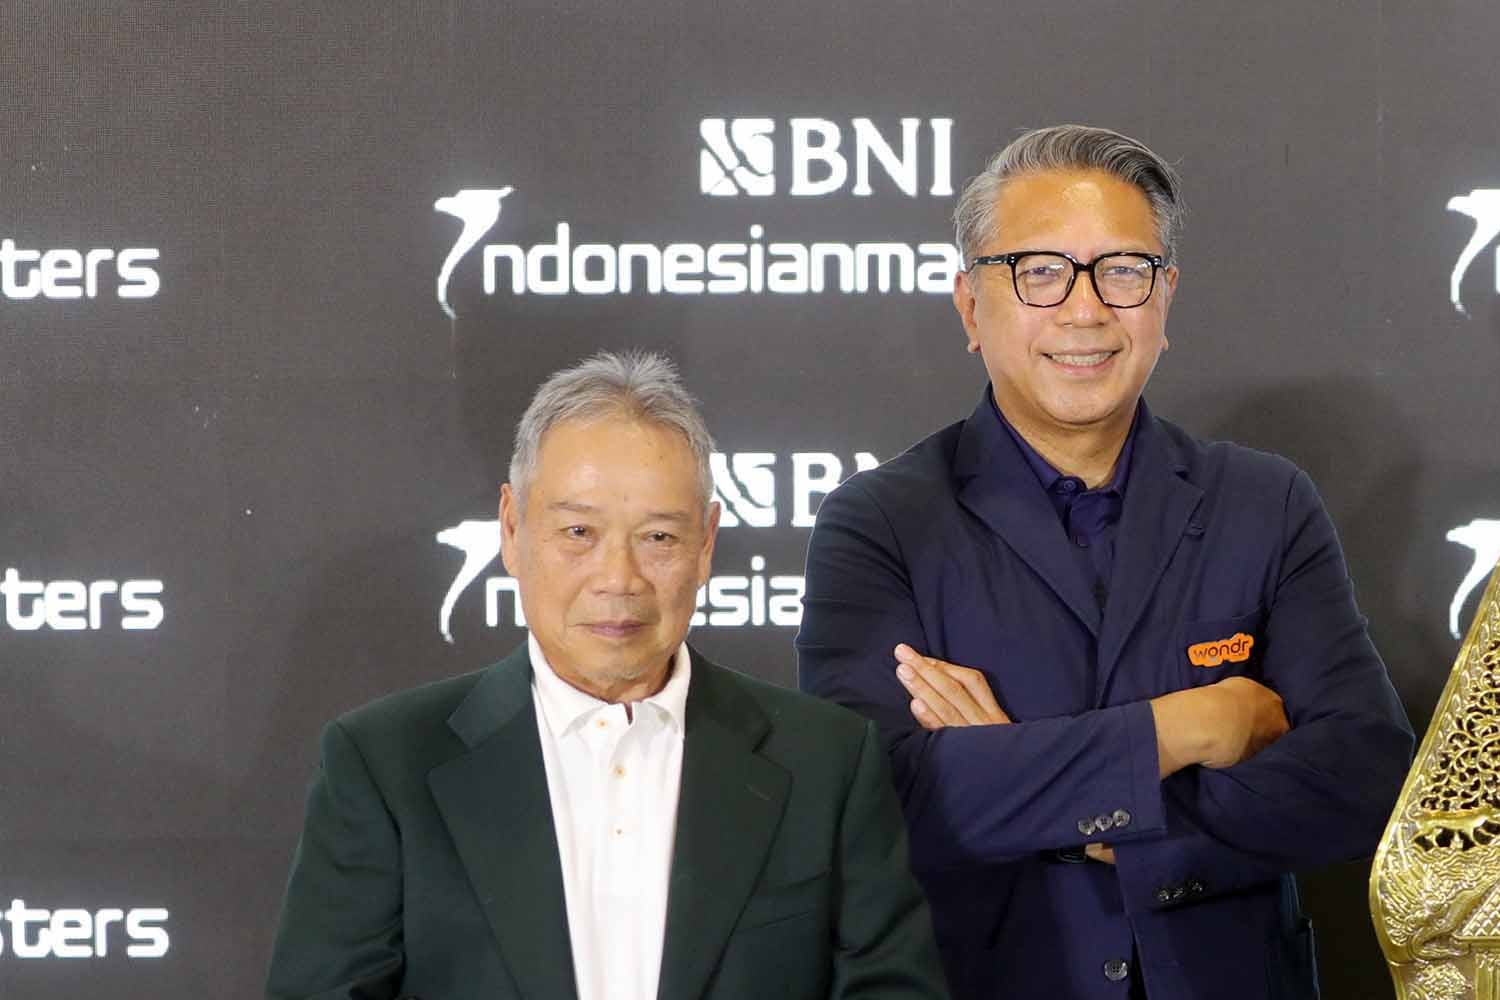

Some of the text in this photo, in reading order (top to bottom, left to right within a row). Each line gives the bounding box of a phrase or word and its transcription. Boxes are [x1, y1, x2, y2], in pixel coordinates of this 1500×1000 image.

[790, 117, 954, 197] BNI
[1193, 638, 1249, 659] wondr
[0, 898, 170, 958] ters
